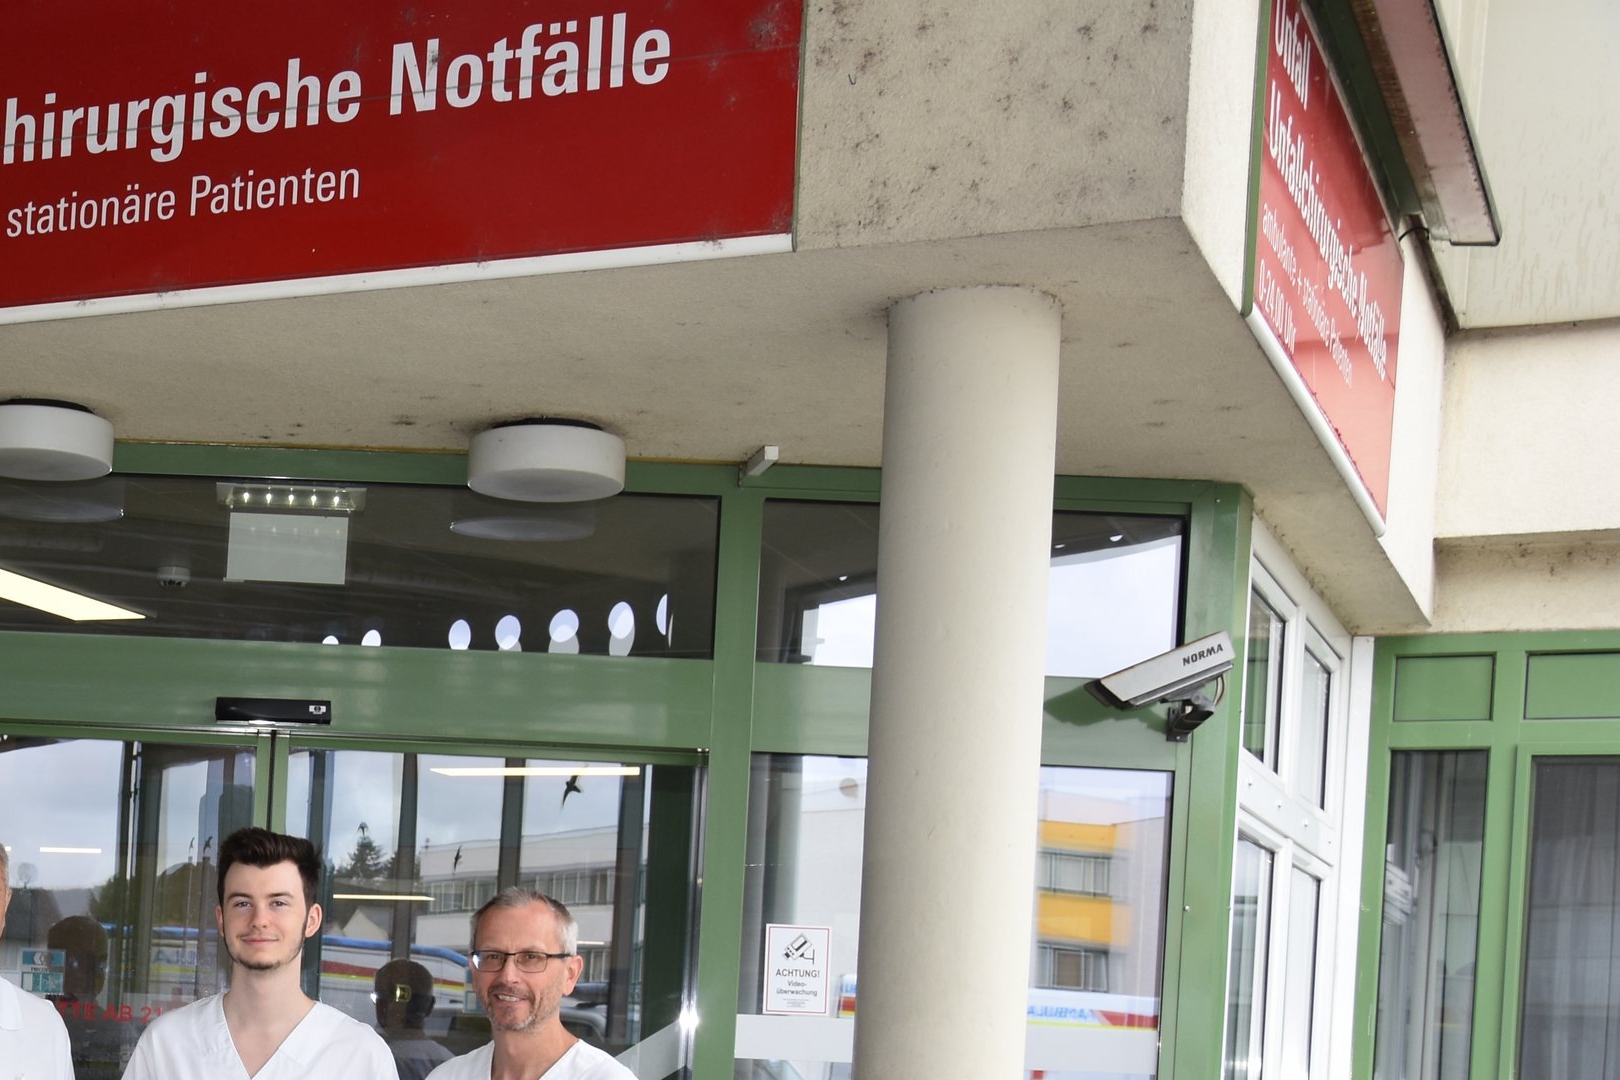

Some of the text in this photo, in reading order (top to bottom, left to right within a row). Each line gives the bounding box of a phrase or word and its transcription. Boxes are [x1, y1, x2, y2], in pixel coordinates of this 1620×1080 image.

[389, 12, 672, 116] Notfälle
[1274, 0, 1311, 112] Unfall
[6, 183, 176, 238] stationäre
[190, 167, 360, 217] Patienten
[1269, 79, 1387, 382] Unfallchirurgische Notfälle
[1262, 202, 1297, 287] ambulante
[1283, 301, 1297, 355] Uhr
[1182, 643, 1224, 667] NORMA
[775, 968, 820, 978] ACHTUNG!
[102, 1004, 134, 1023] AB
